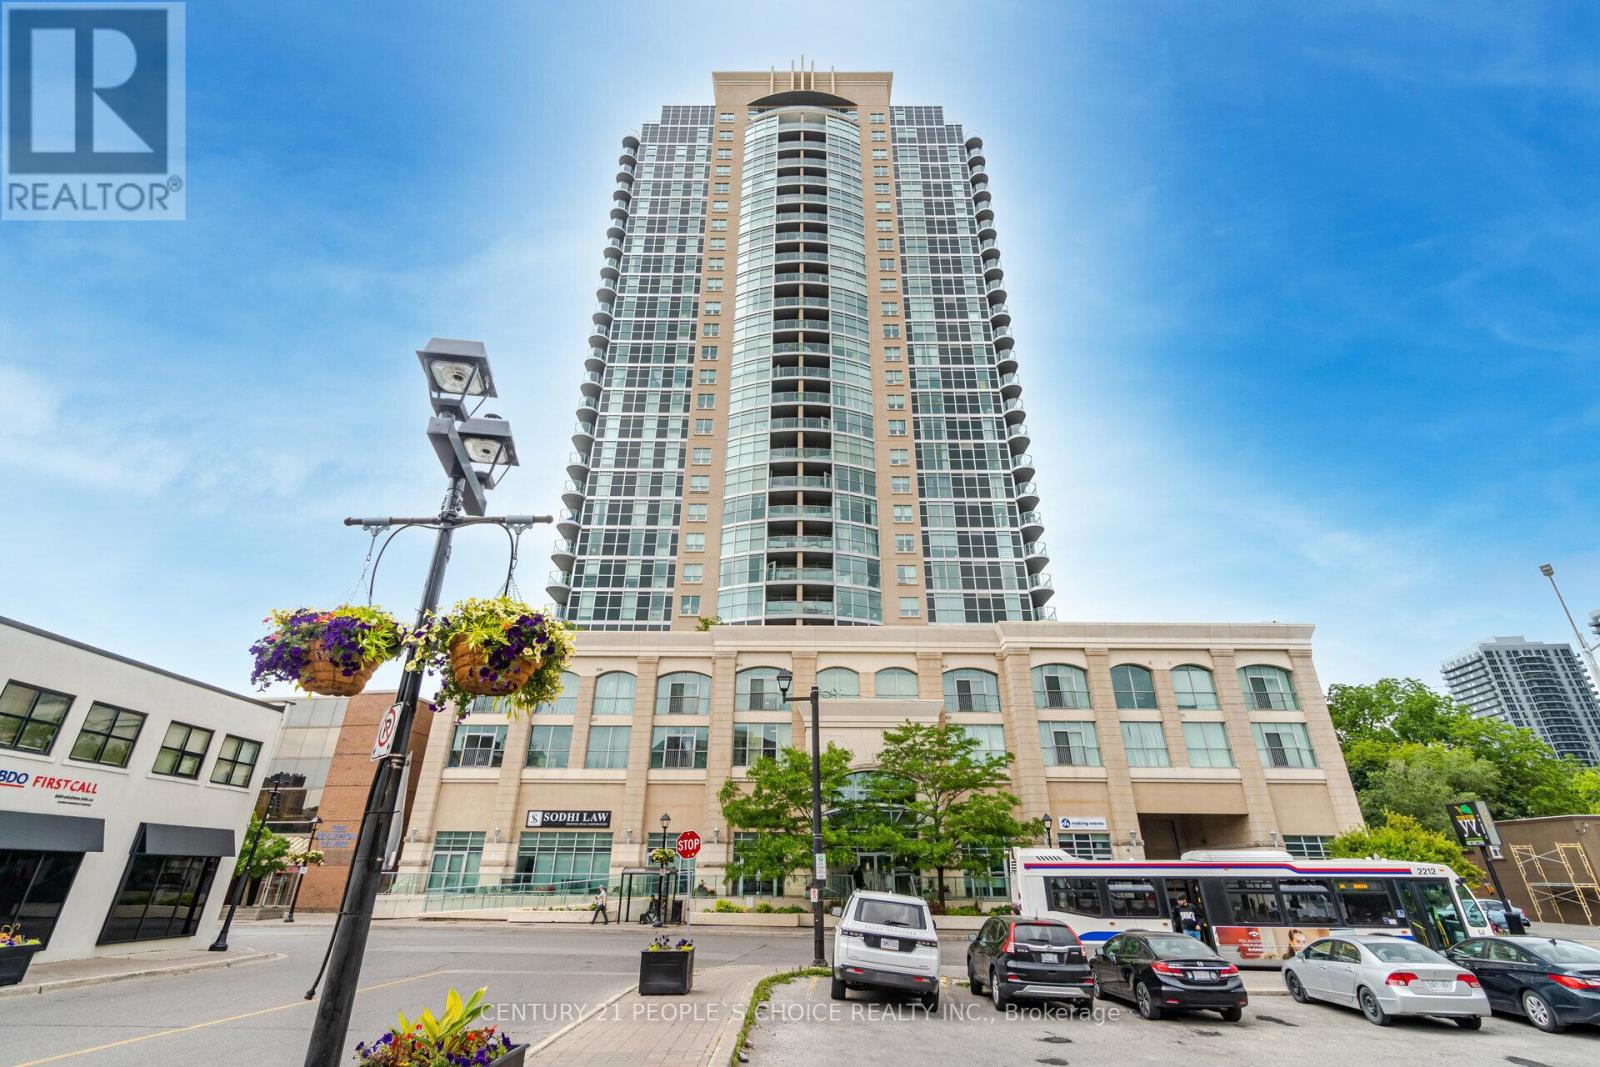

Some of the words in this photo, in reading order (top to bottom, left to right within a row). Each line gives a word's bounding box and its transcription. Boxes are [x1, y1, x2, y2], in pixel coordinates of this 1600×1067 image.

[0, 770, 29, 785] BDO
[543, 812, 580, 822] SODHI
[582, 812, 609, 822] LAW
[678, 838, 700, 851] STOP
[1417, 868, 1437, 876] 2212
